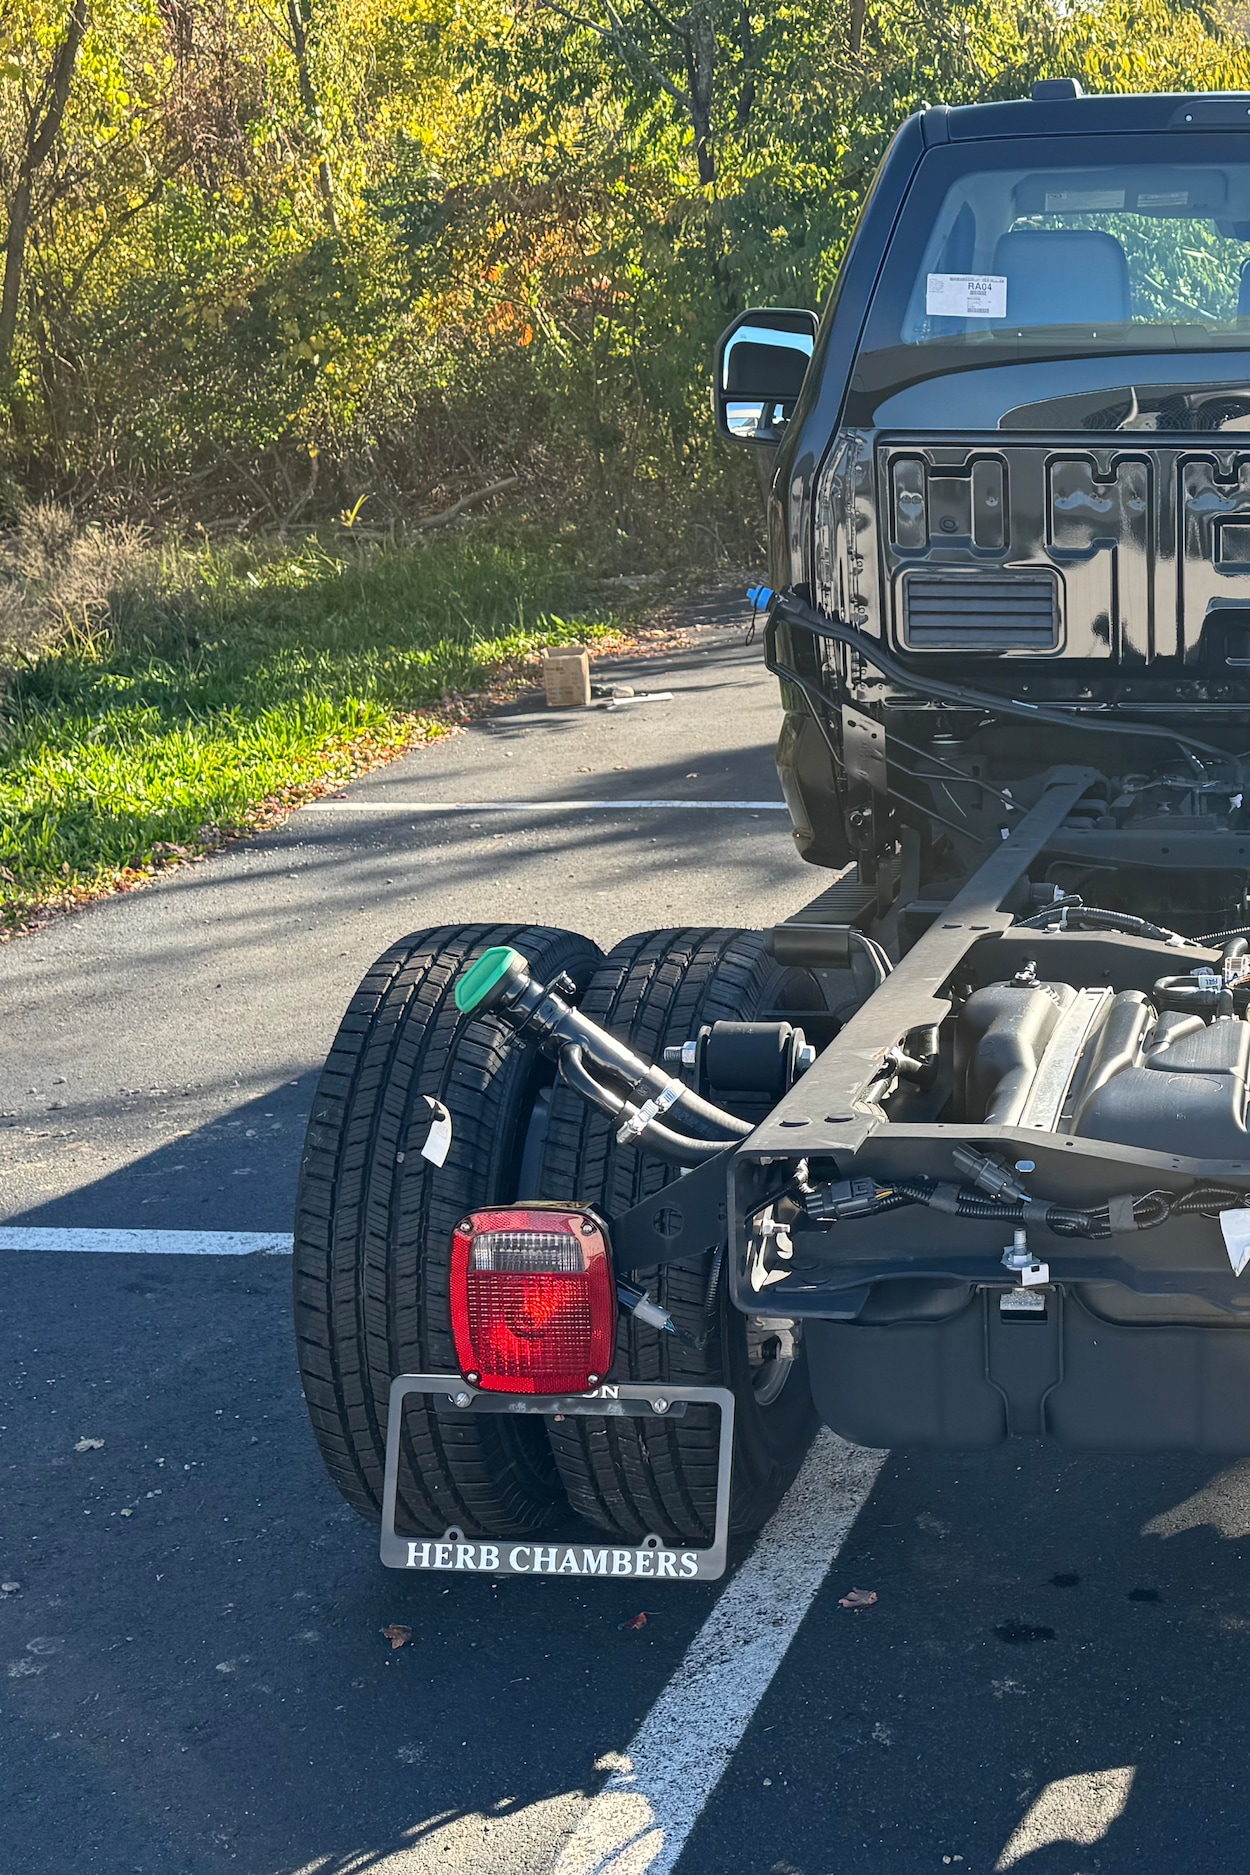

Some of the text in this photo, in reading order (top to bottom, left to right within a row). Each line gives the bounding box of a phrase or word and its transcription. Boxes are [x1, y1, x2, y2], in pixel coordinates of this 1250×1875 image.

[967, 282, 992, 291] RA04
[406, 1542, 699, 1578] HERB CHAMBERS
